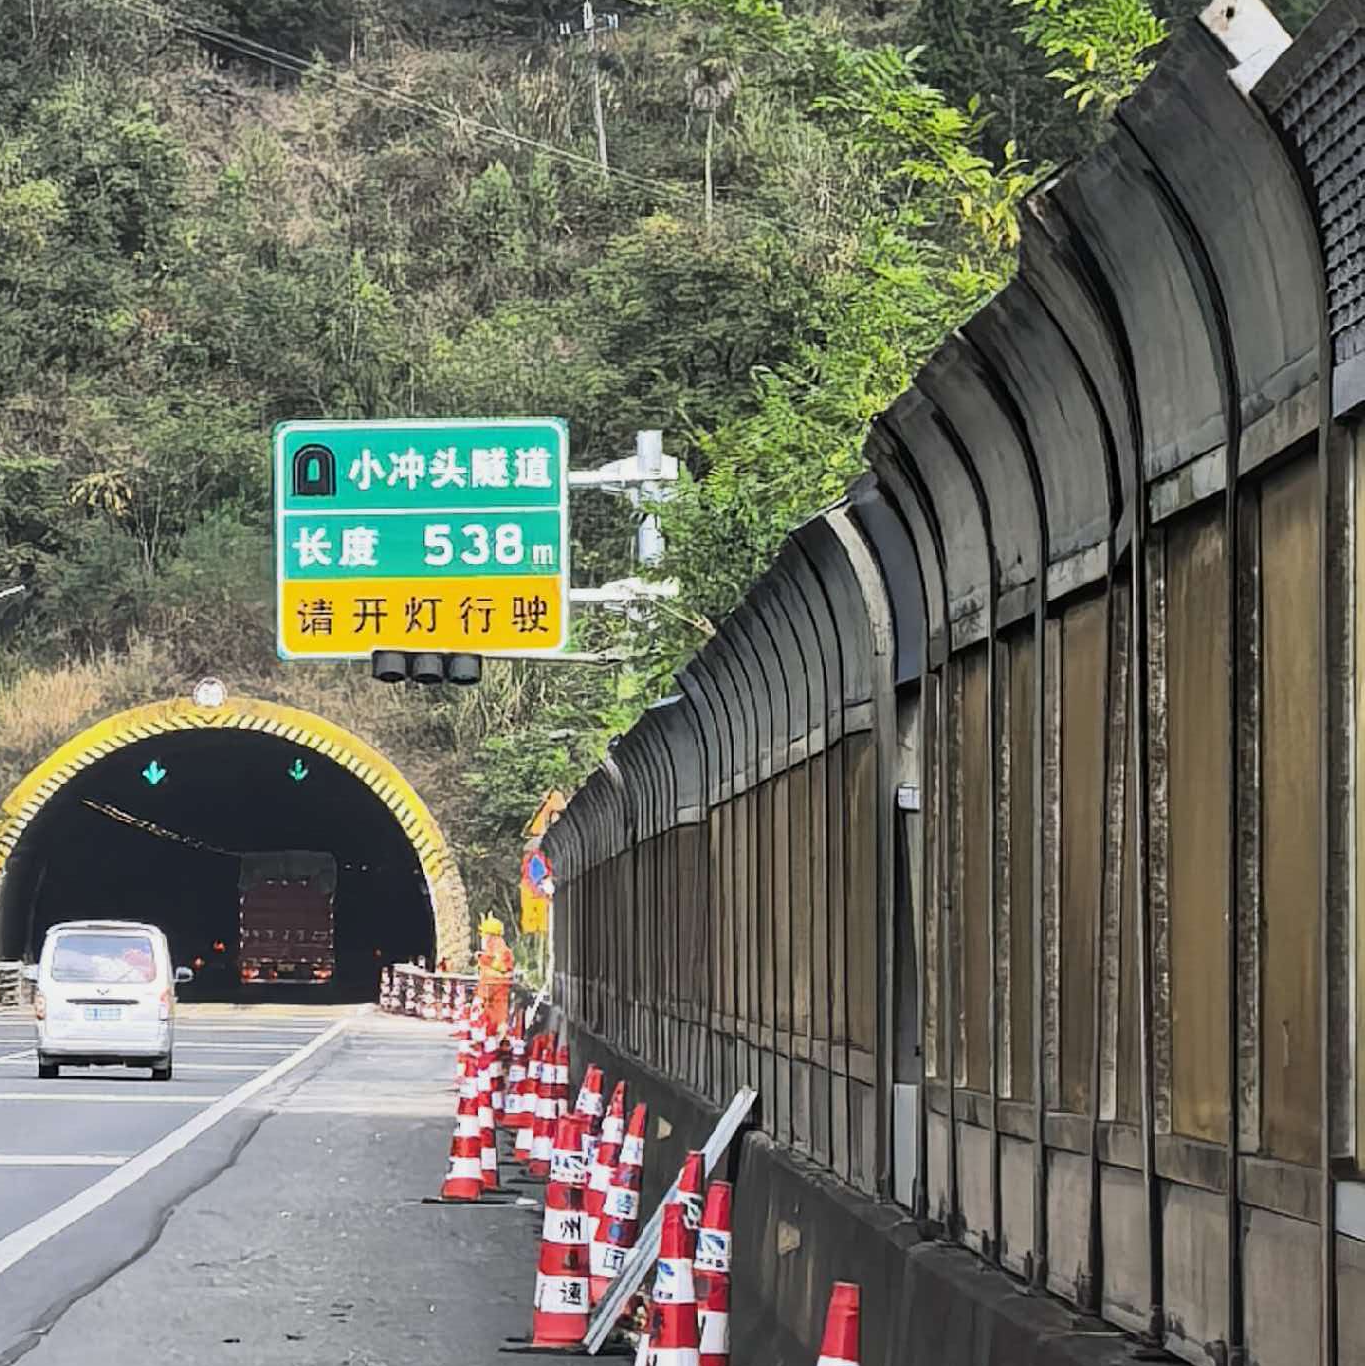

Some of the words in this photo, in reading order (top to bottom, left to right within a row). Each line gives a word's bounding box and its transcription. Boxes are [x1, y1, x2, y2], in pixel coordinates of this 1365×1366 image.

[348, 447, 553, 491] 小冲头隧道
[292, 526, 381, 567] 长度
[297, 596, 549, 636] 请开灯行驶
